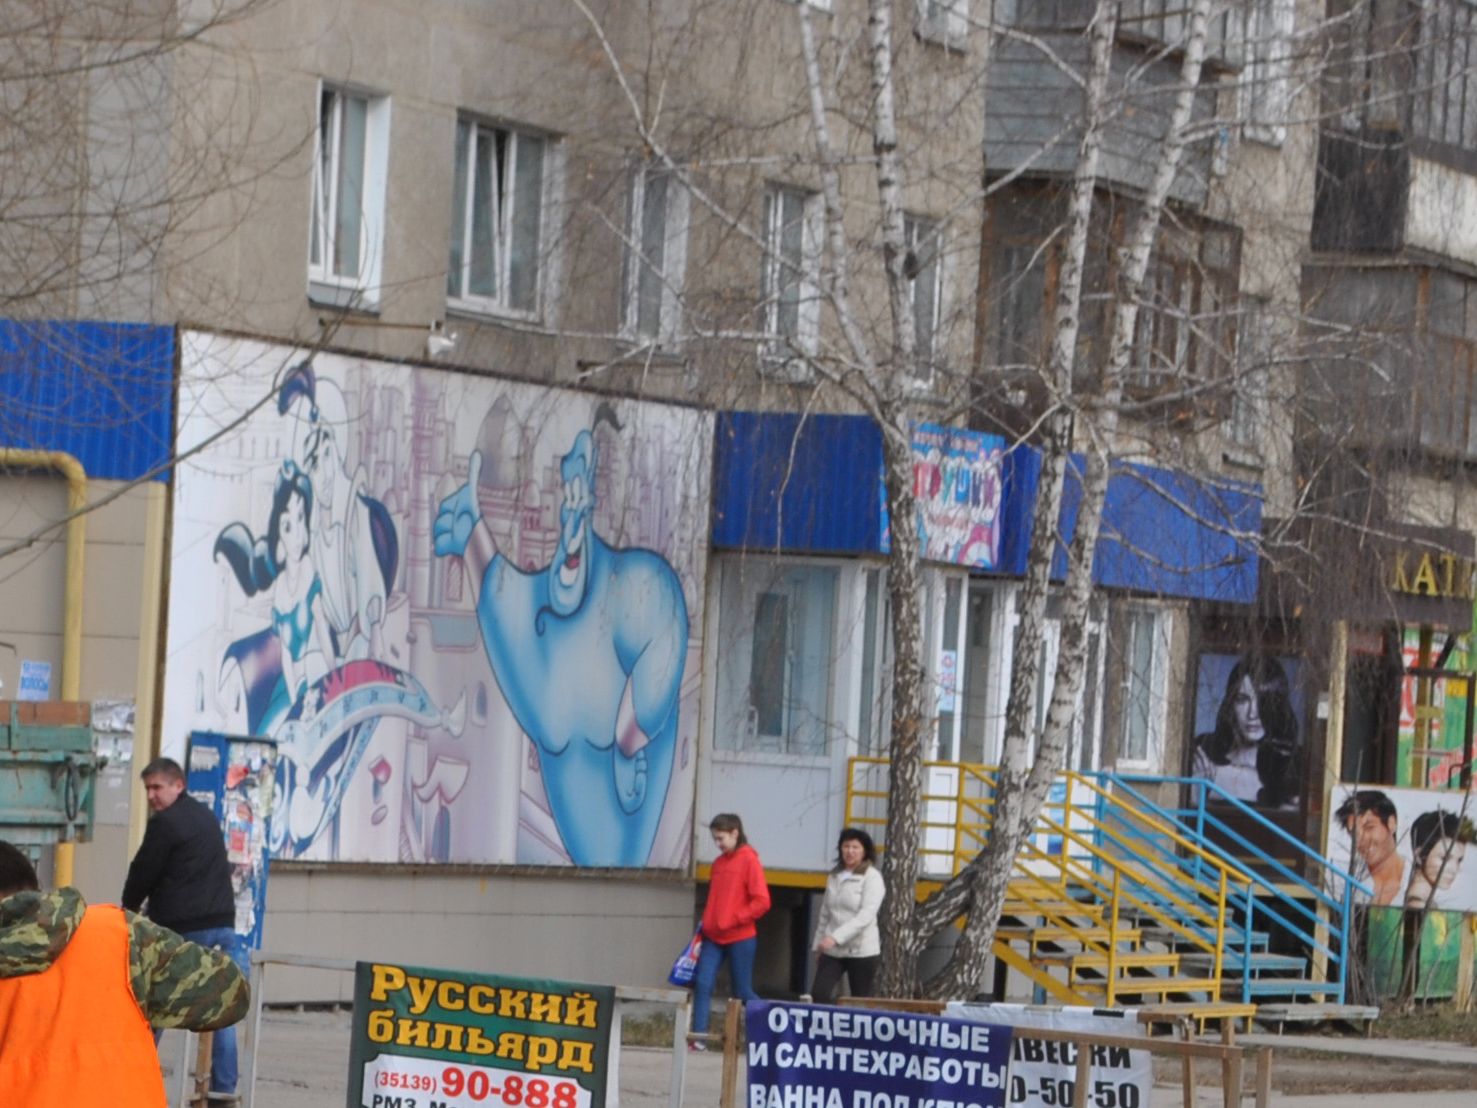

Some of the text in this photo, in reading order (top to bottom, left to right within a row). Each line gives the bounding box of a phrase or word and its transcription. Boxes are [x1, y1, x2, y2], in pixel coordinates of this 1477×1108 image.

[371, 964, 598, 1029] Русский
[367, 1009, 595, 1072] бильярд
[767, 1007, 991, 1054] ОТДЕЛОЧНЫЕ
[374, 1071, 438, 1095] (35139)
[748, 1043, 1007, 1090] И САНТЕХРАБОТЫ
